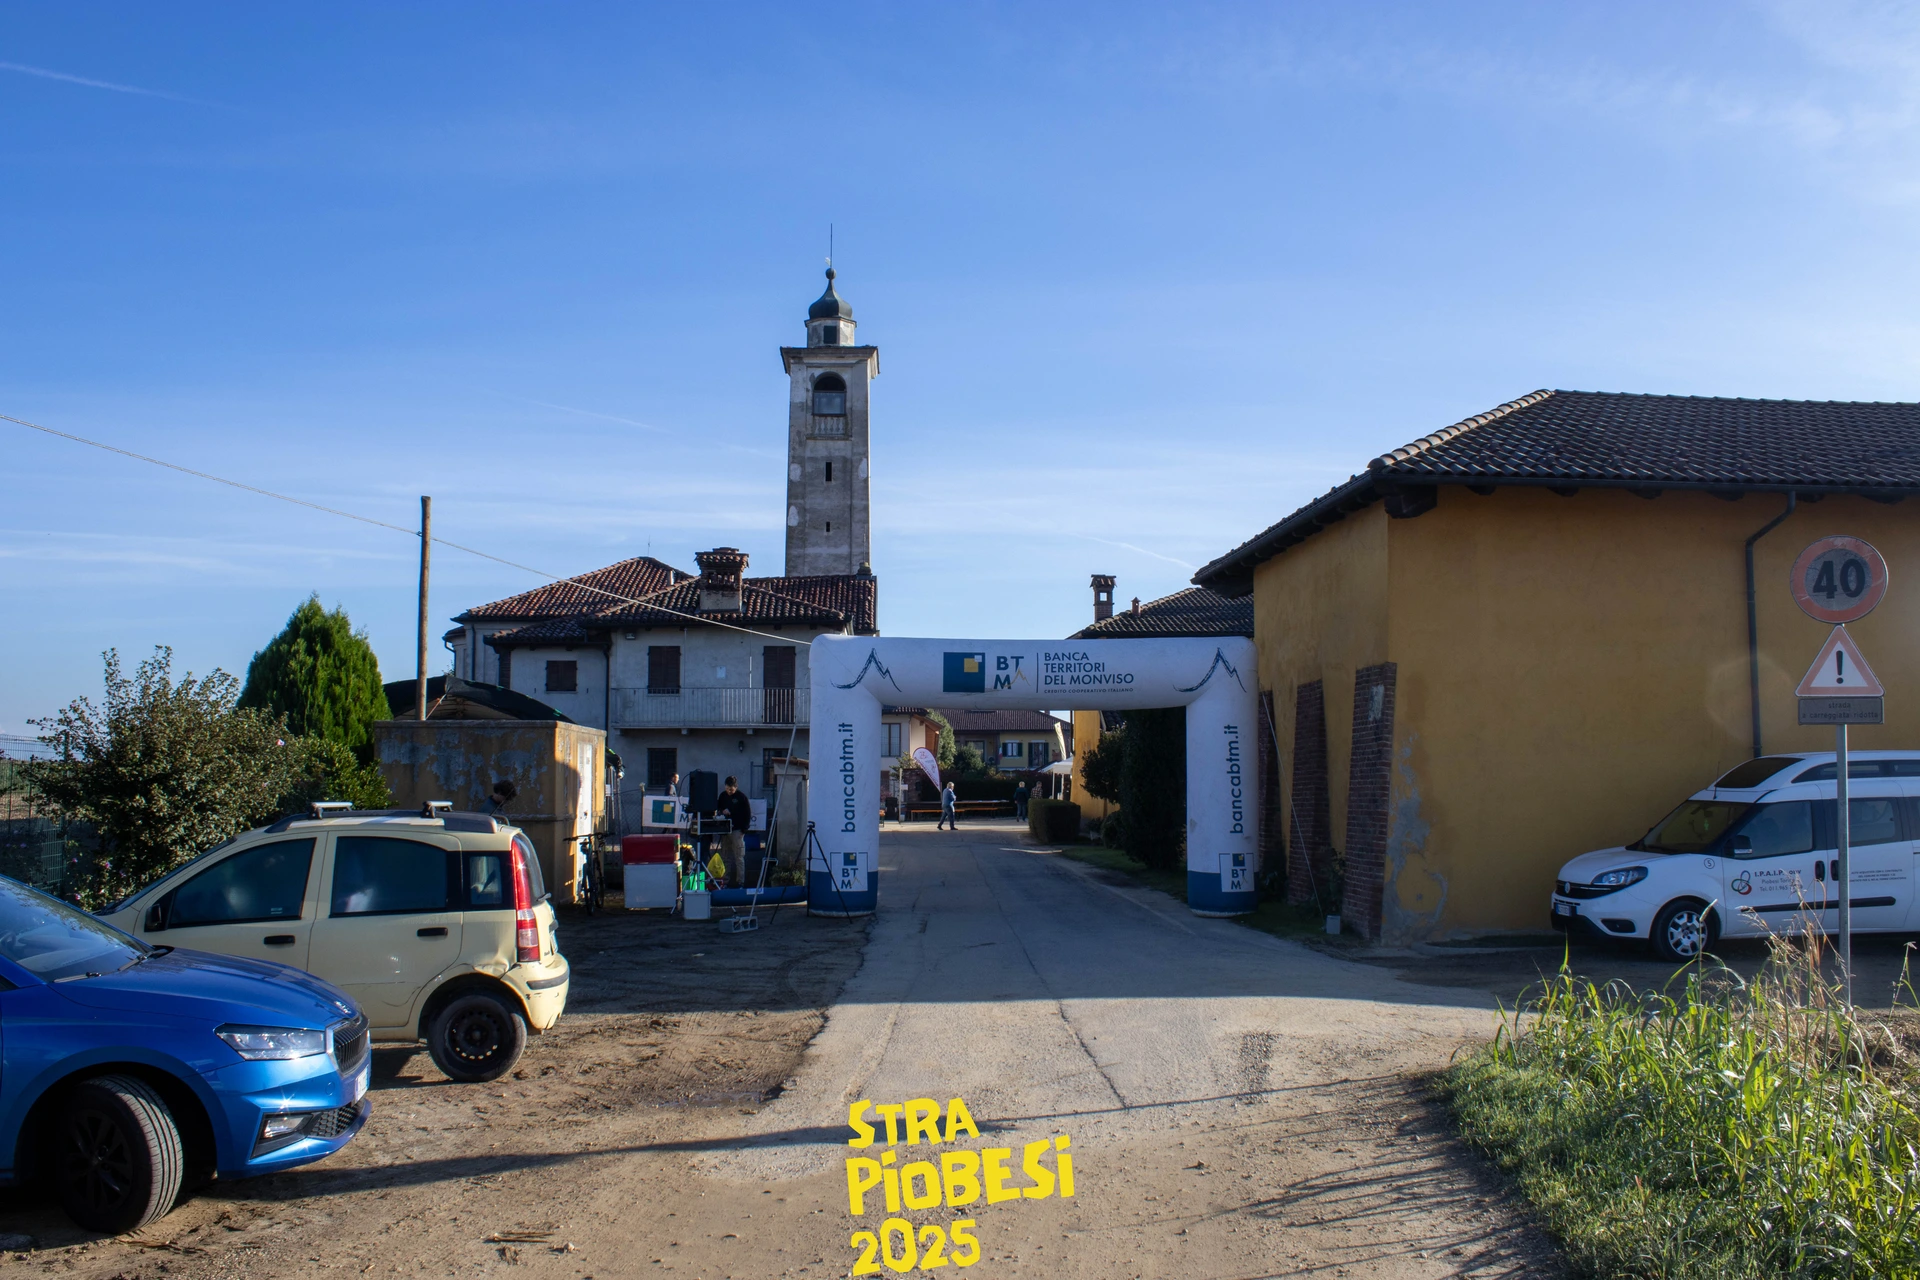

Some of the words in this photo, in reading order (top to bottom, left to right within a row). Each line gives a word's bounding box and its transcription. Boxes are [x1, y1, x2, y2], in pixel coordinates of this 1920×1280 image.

[1813, 559, 1866, 599] 40
[1044, 651, 1090, 662] BANCA
[1044, 662, 1105, 673] TERRITORI
[1044, 675, 1066, 686] DEL
[1069, 673, 1134, 685] MONVISO
[1809, 711, 1850, 720] carreggiata
[1853, 711, 1879, 719] ridotta
[838, 722, 856, 833] bancabtm.it
[1224, 724, 1244, 834] bancabtm.it
